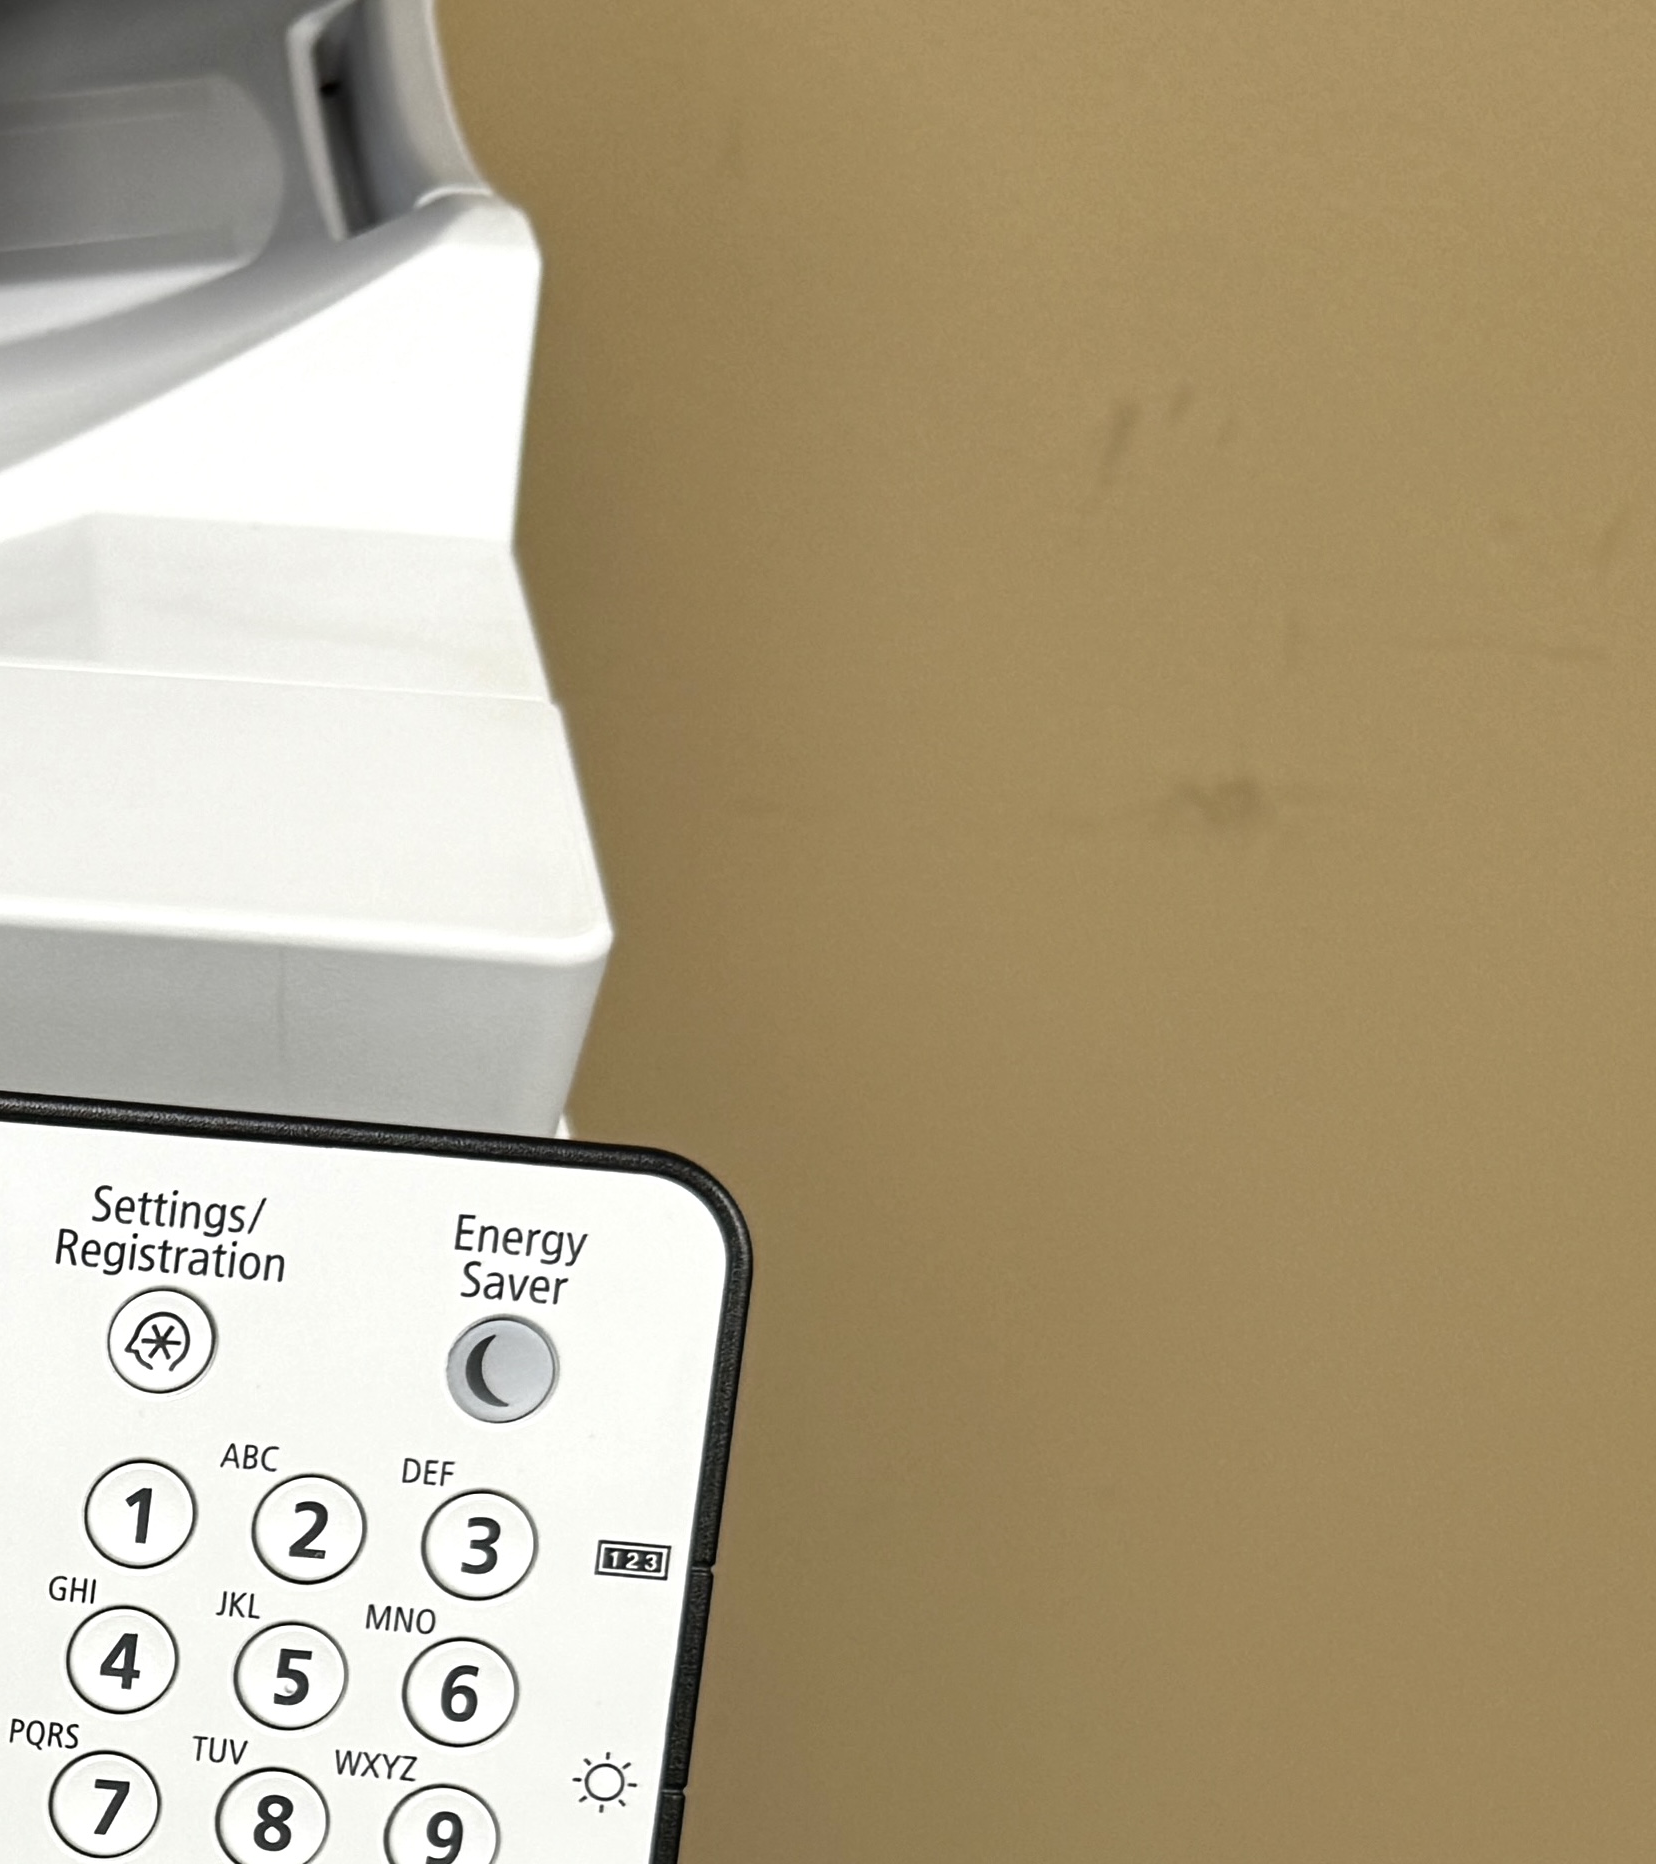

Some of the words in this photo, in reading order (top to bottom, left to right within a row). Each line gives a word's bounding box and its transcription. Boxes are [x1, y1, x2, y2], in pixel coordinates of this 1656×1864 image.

[90, 1185, 267, 1235] Settings/
[54, 1228, 286, 1283] Registration
[453, 1213, 589, 1266] Energy
[460, 1261, 569, 1305] Saver
[219, 1443, 280, 1472] ABC
[401, 1458, 456, 1488] DEF
[124, 1487, 154, 1544] 1
[288, 1501, 330, 1559] 2
[460, 1516, 502, 1574] 3
[47, 1575, 97, 1605] GHI
[215, 1591, 262, 1620] JKL
[365, 1604, 437, 1635] MNO
[99, 1632, 141, 1689] 4
[272, 1648, 314, 1706] 5
[439, 1665, 480, 1722] 6
[8, 1718, 81, 1750] PQRS
[192, 1736, 249, 1765] TUV
[334, 1749, 418, 1782] WXYZ
[92, 1778, 131, 1835] 7
[252, 1793, 295, 1852] 8
